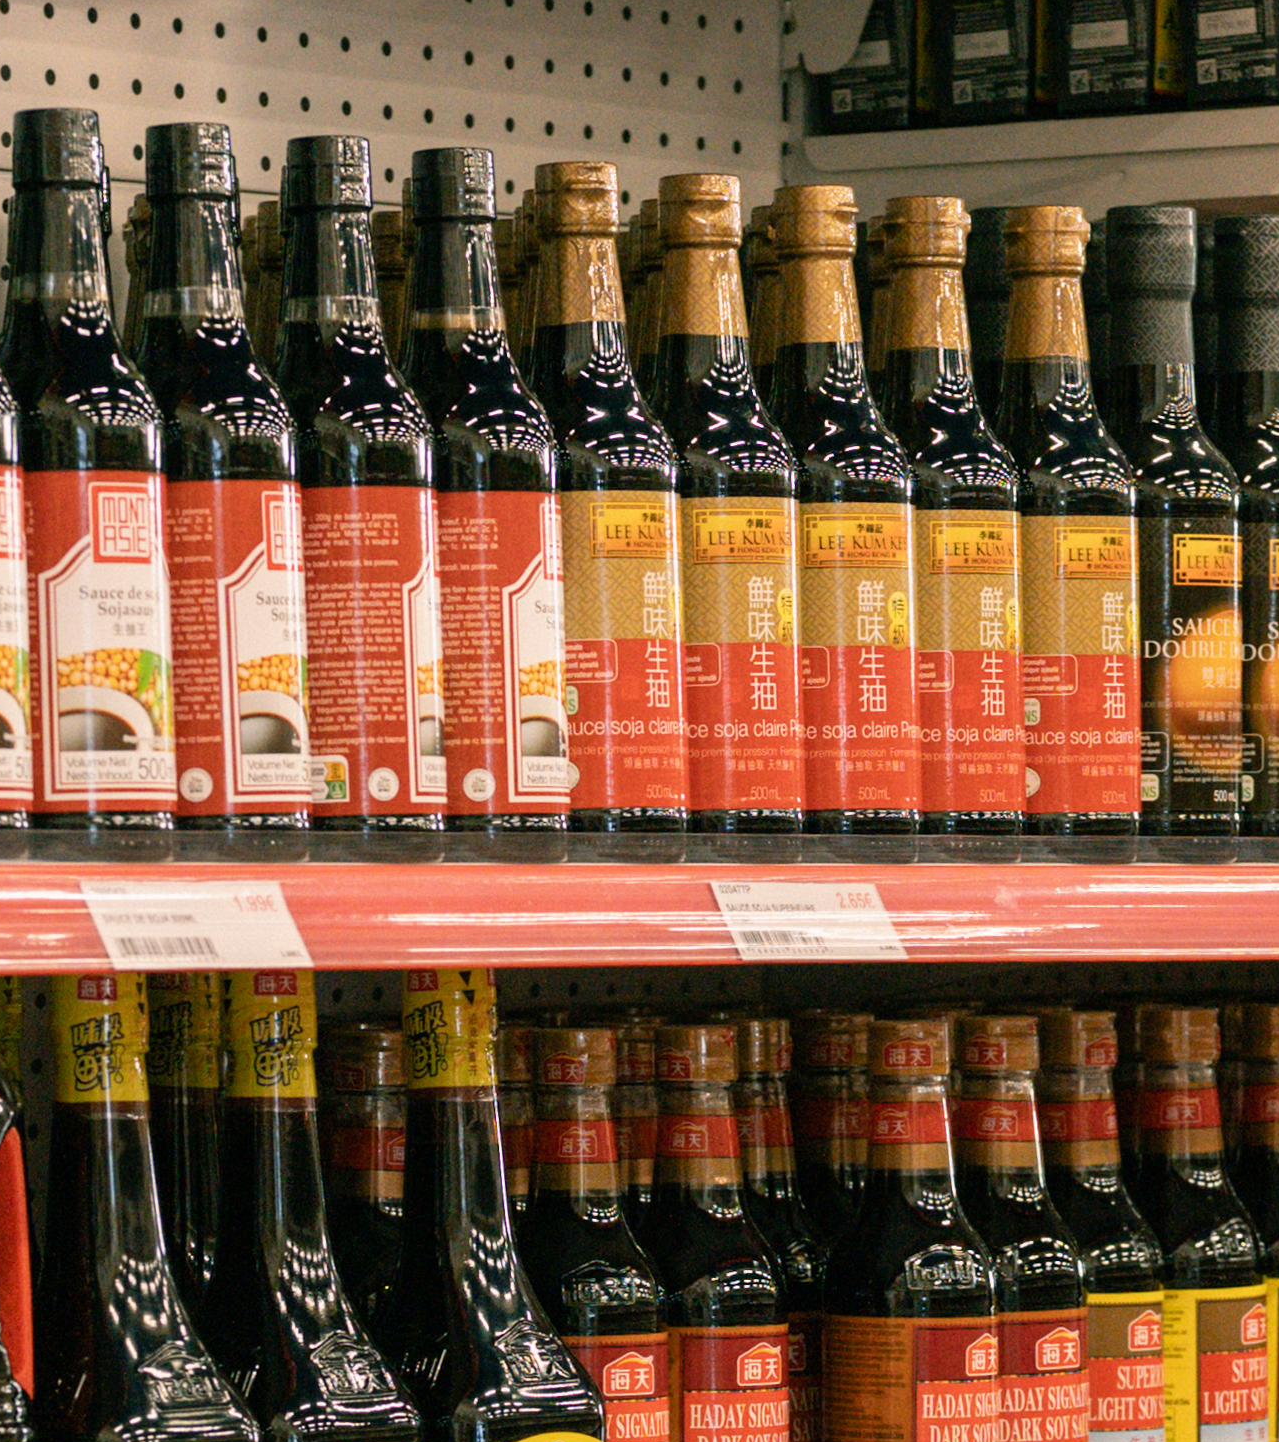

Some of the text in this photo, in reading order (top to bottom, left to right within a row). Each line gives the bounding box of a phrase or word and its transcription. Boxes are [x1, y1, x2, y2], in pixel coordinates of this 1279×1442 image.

[103, 496, 146, 523] MONT
[103, 526, 147, 553] ASIE
[605, 525, 632, 539] LEE
[708, 530, 777, 545] LEE KUM
[818, 536, 887, 550] LEE KUM
[945, 543, 1004, 556] LEE KUM
[1068, 548, 1092, 562] LEE
[79, 585, 124, 600] Sauce
[1172, 618, 1230, 636] SAUCE
[643, 572, 670, 708] 鮮味生抽
[748, 576, 777, 711] 鮮味生抽
[857, 580, 887, 713] 鮮味生抽
[1143, 640, 1228, 659] DOUBLE
[979, 587, 1005, 716] 鮮味生抽
[1102, 591, 1126, 719] 鮮味生抽
[611, 717, 678, 738] soja claire
[714, 720, 788, 742] soja claire
[822, 720, 899, 741] soja claire
[947, 724, 1015, 746] soja claire
[1070, 727, 1102, 747] soja
[750, 786, 781, 799] 500mL
[858, 787, 891, 801] 500mL
[836, 892, 876, 909] 2.65€
[610, 1369, 650, 1391] 海天
[744, 1358, 779, 1381] 海天
[922, 1392, 970, 1419] HADAY
[1203, 1392, 1248, 1416] LIGHT
[690, 1402, 744, 1430] HADAY
